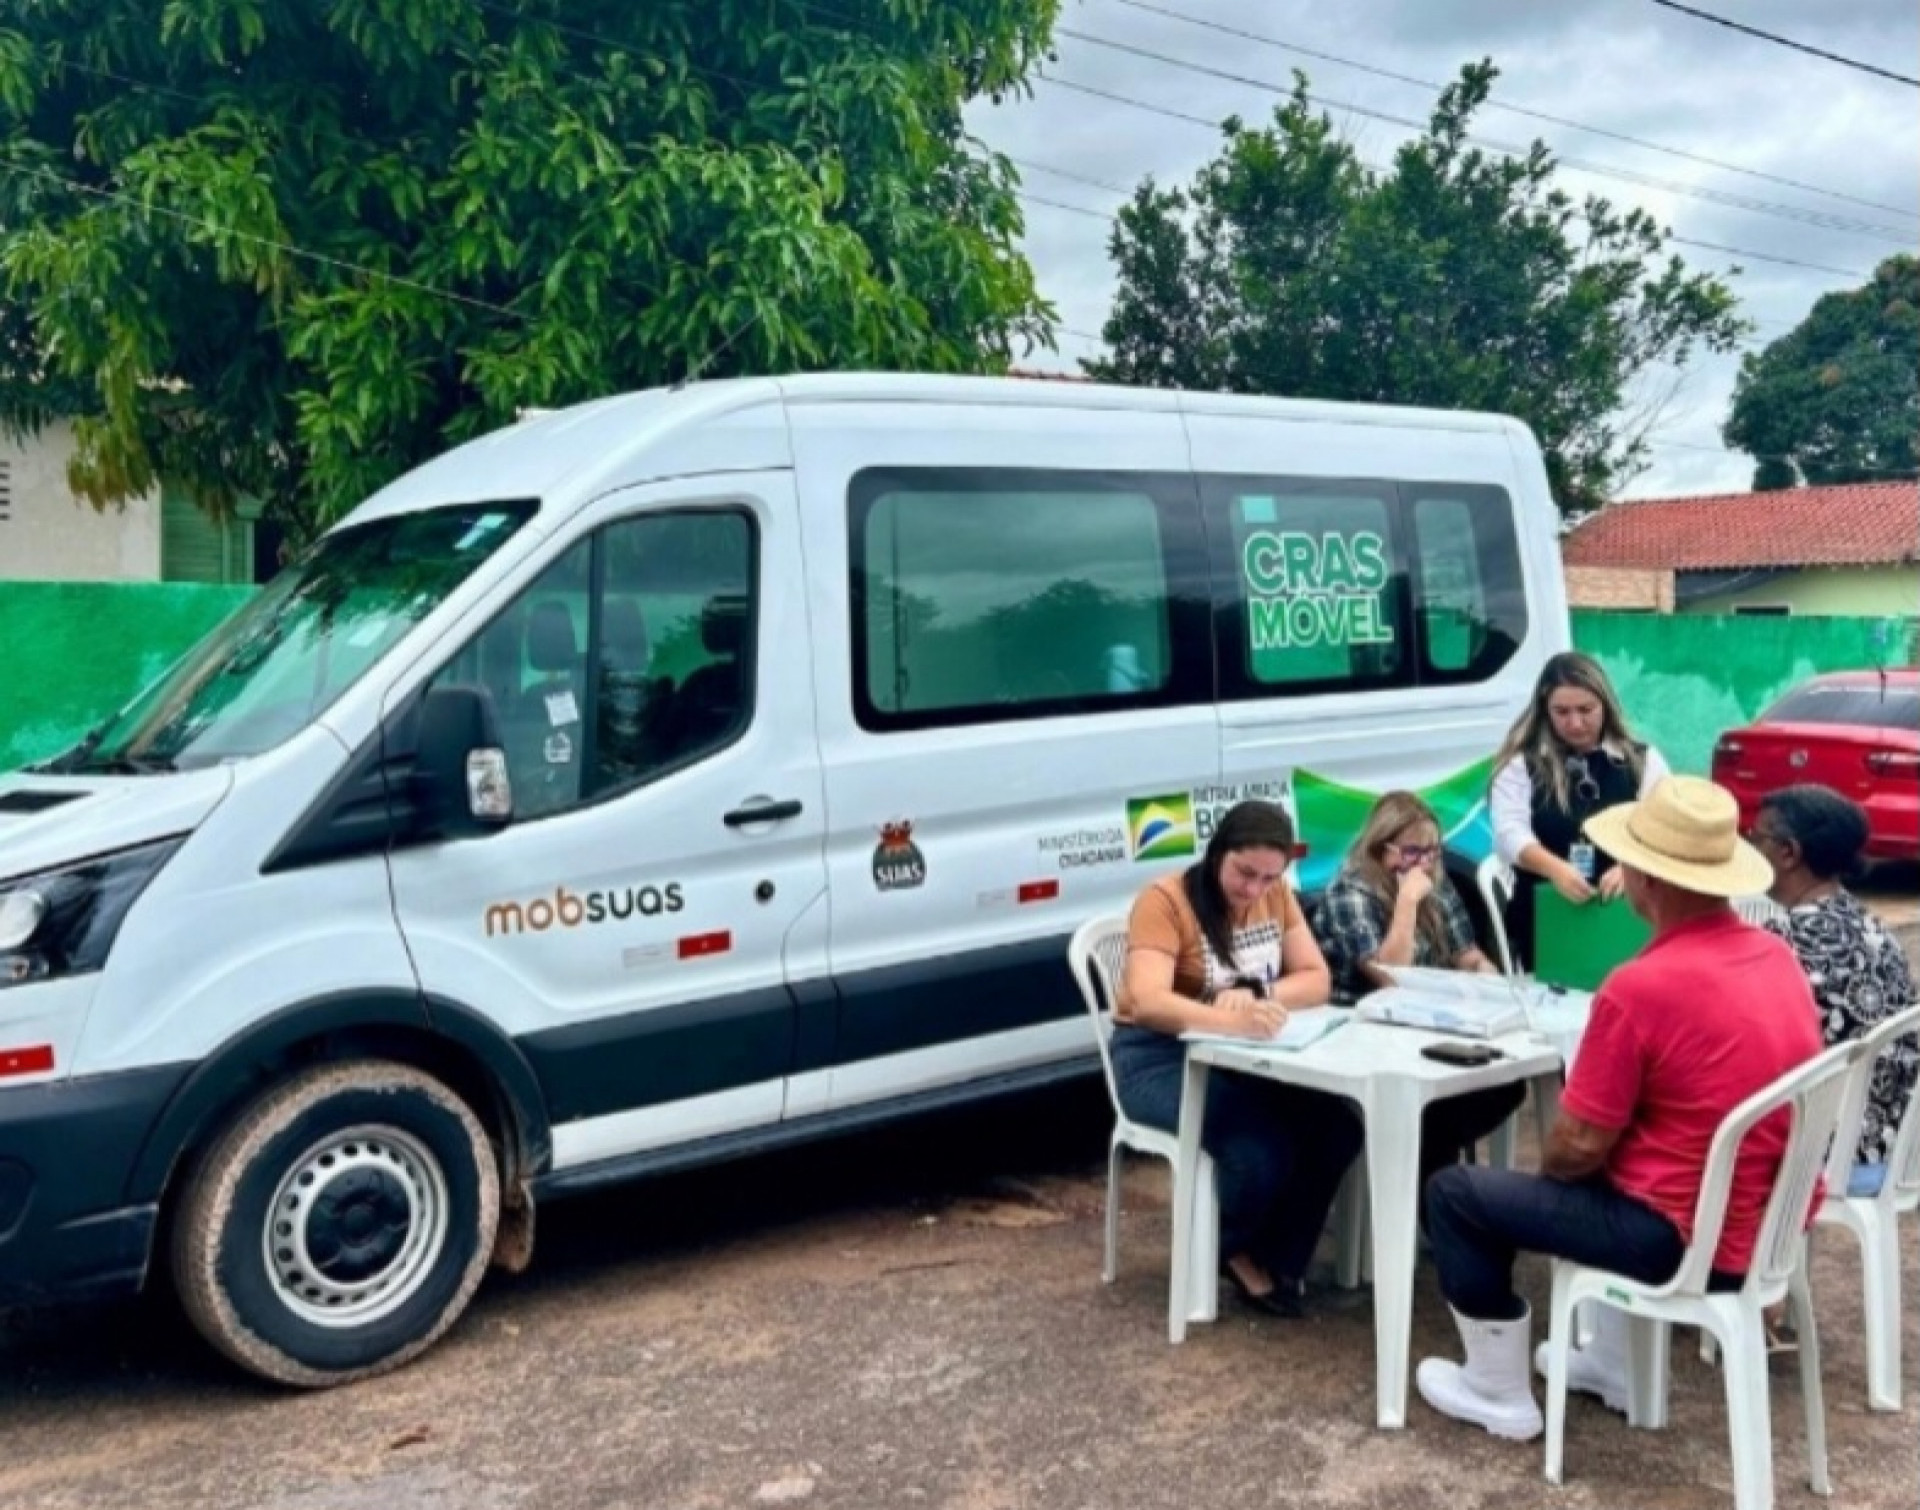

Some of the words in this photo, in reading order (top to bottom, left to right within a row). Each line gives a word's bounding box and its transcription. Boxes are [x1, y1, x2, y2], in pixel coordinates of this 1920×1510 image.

[1245, 531, 1387, 593] CRAS
[876, 861, 925, 884] SUAS
[485, 881, 685, 937] mobsuas
